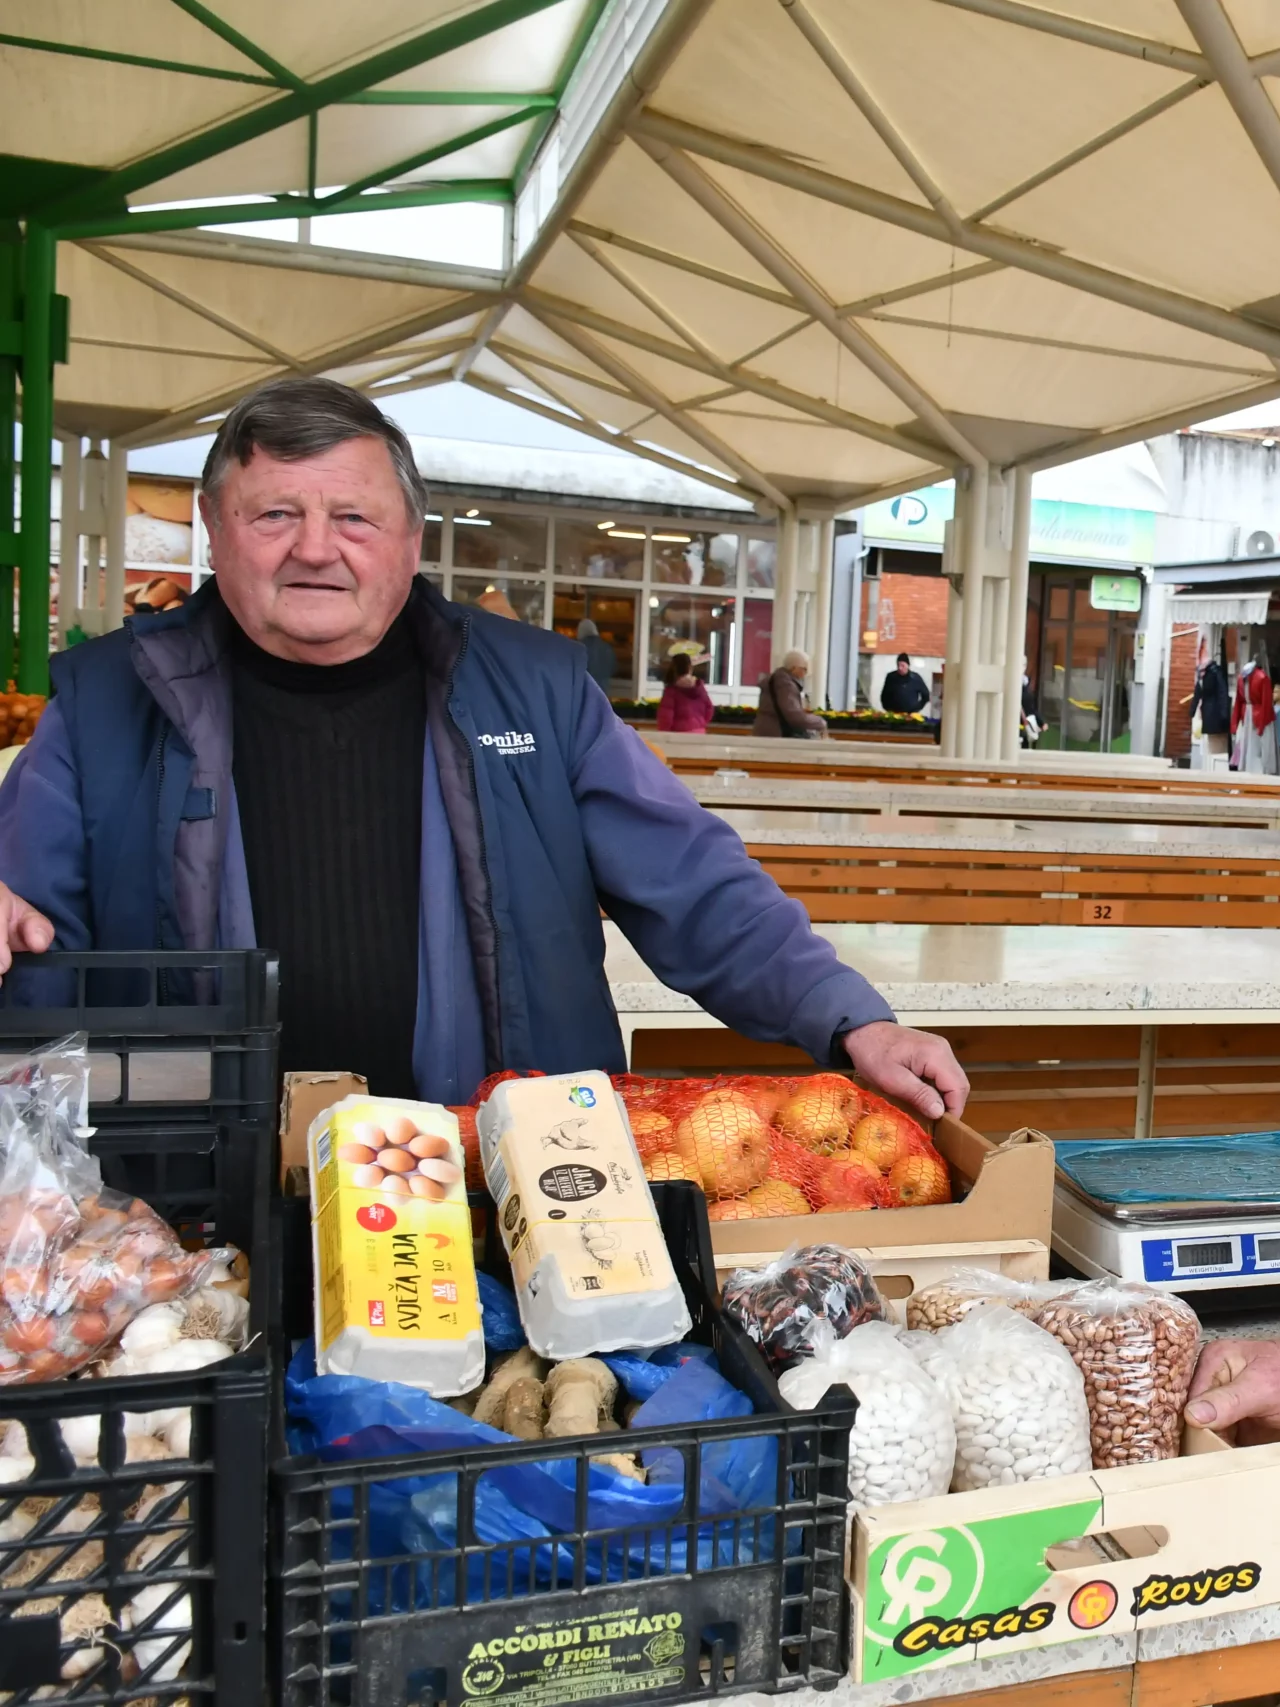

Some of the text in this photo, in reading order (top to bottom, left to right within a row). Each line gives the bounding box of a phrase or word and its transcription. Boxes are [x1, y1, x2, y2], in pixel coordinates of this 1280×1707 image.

[1093, 905, 1112, 920] 32
[570, 1167, 598, 1196] JAJCA
[387, 1233, 422, 1331] SVJEŽA JAJA
[432, 1259, 445, 1272] 10
[1137, 1567, 1254, 1608] Royes
[468, 1627, 582, 1660] ACCORDI
[587, 1612, 682, 1643] RENATO
[901, 1606, 1050, 1650] Casas
[563, 1645, 611, 1664] FIGLI
